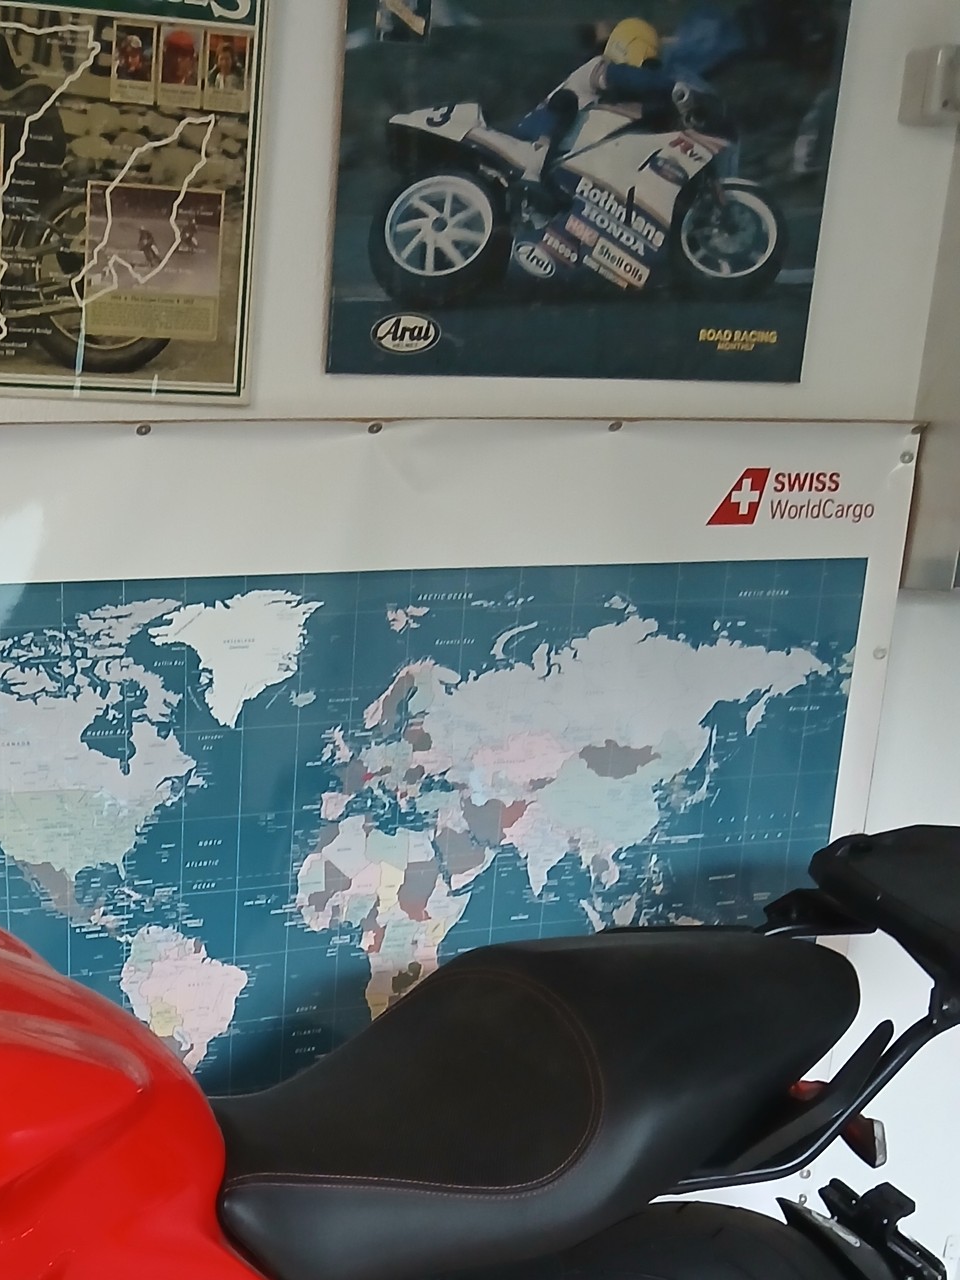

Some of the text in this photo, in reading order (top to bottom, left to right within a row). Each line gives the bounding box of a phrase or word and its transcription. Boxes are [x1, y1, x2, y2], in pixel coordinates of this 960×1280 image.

[377, 317, 432, 341] Arai
[699, 328, 778, 343] ROAD RACING
[773, 472, 840, 492] SWISS
[770, 499, 874, 523] WorldCargo
[185, 859, 219, 868] ATLANTIC
